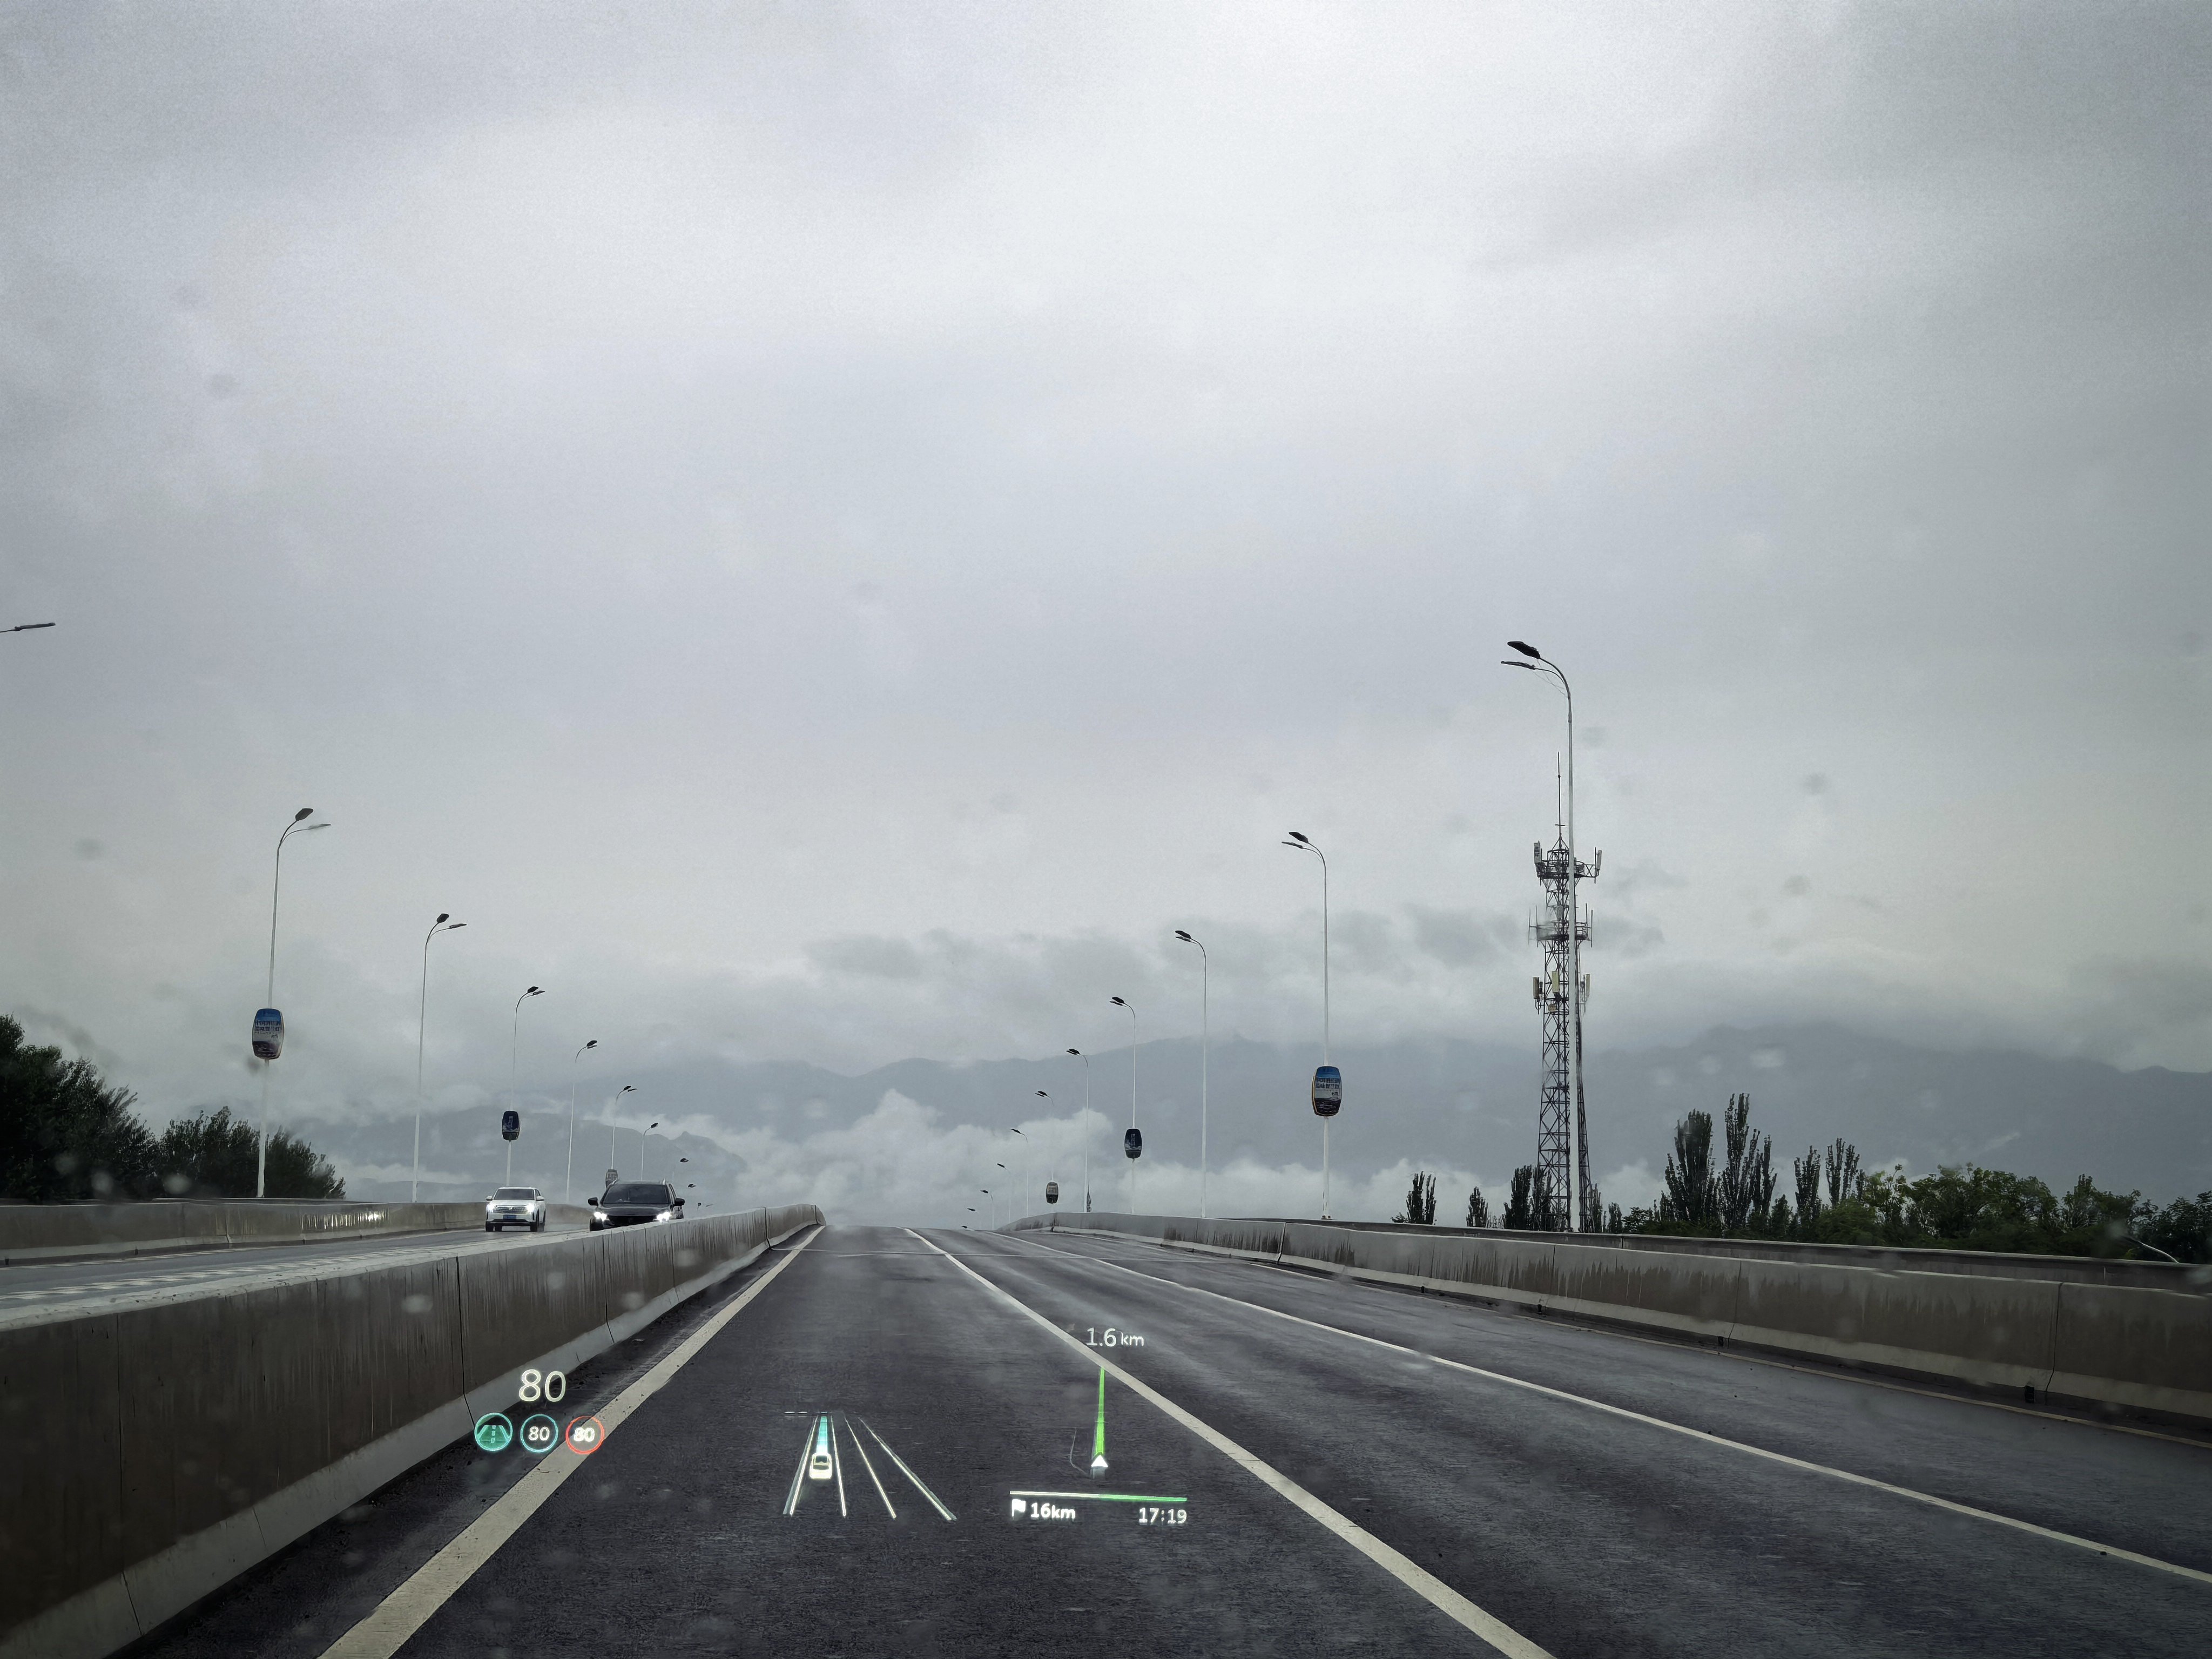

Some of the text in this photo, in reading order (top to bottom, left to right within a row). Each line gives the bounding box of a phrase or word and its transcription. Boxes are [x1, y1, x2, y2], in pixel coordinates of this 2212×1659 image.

[1086, 1327, 1144, 1347] 1.6 km
[520, 1370, 566, 1402] 80
[528, 1426, 550, 1441] 80
[574, 1427, 595, 1442] 80
[1030, 1503, 1076, 1519] 16km
[1139, 1508, 1188, 1524] 17:19
